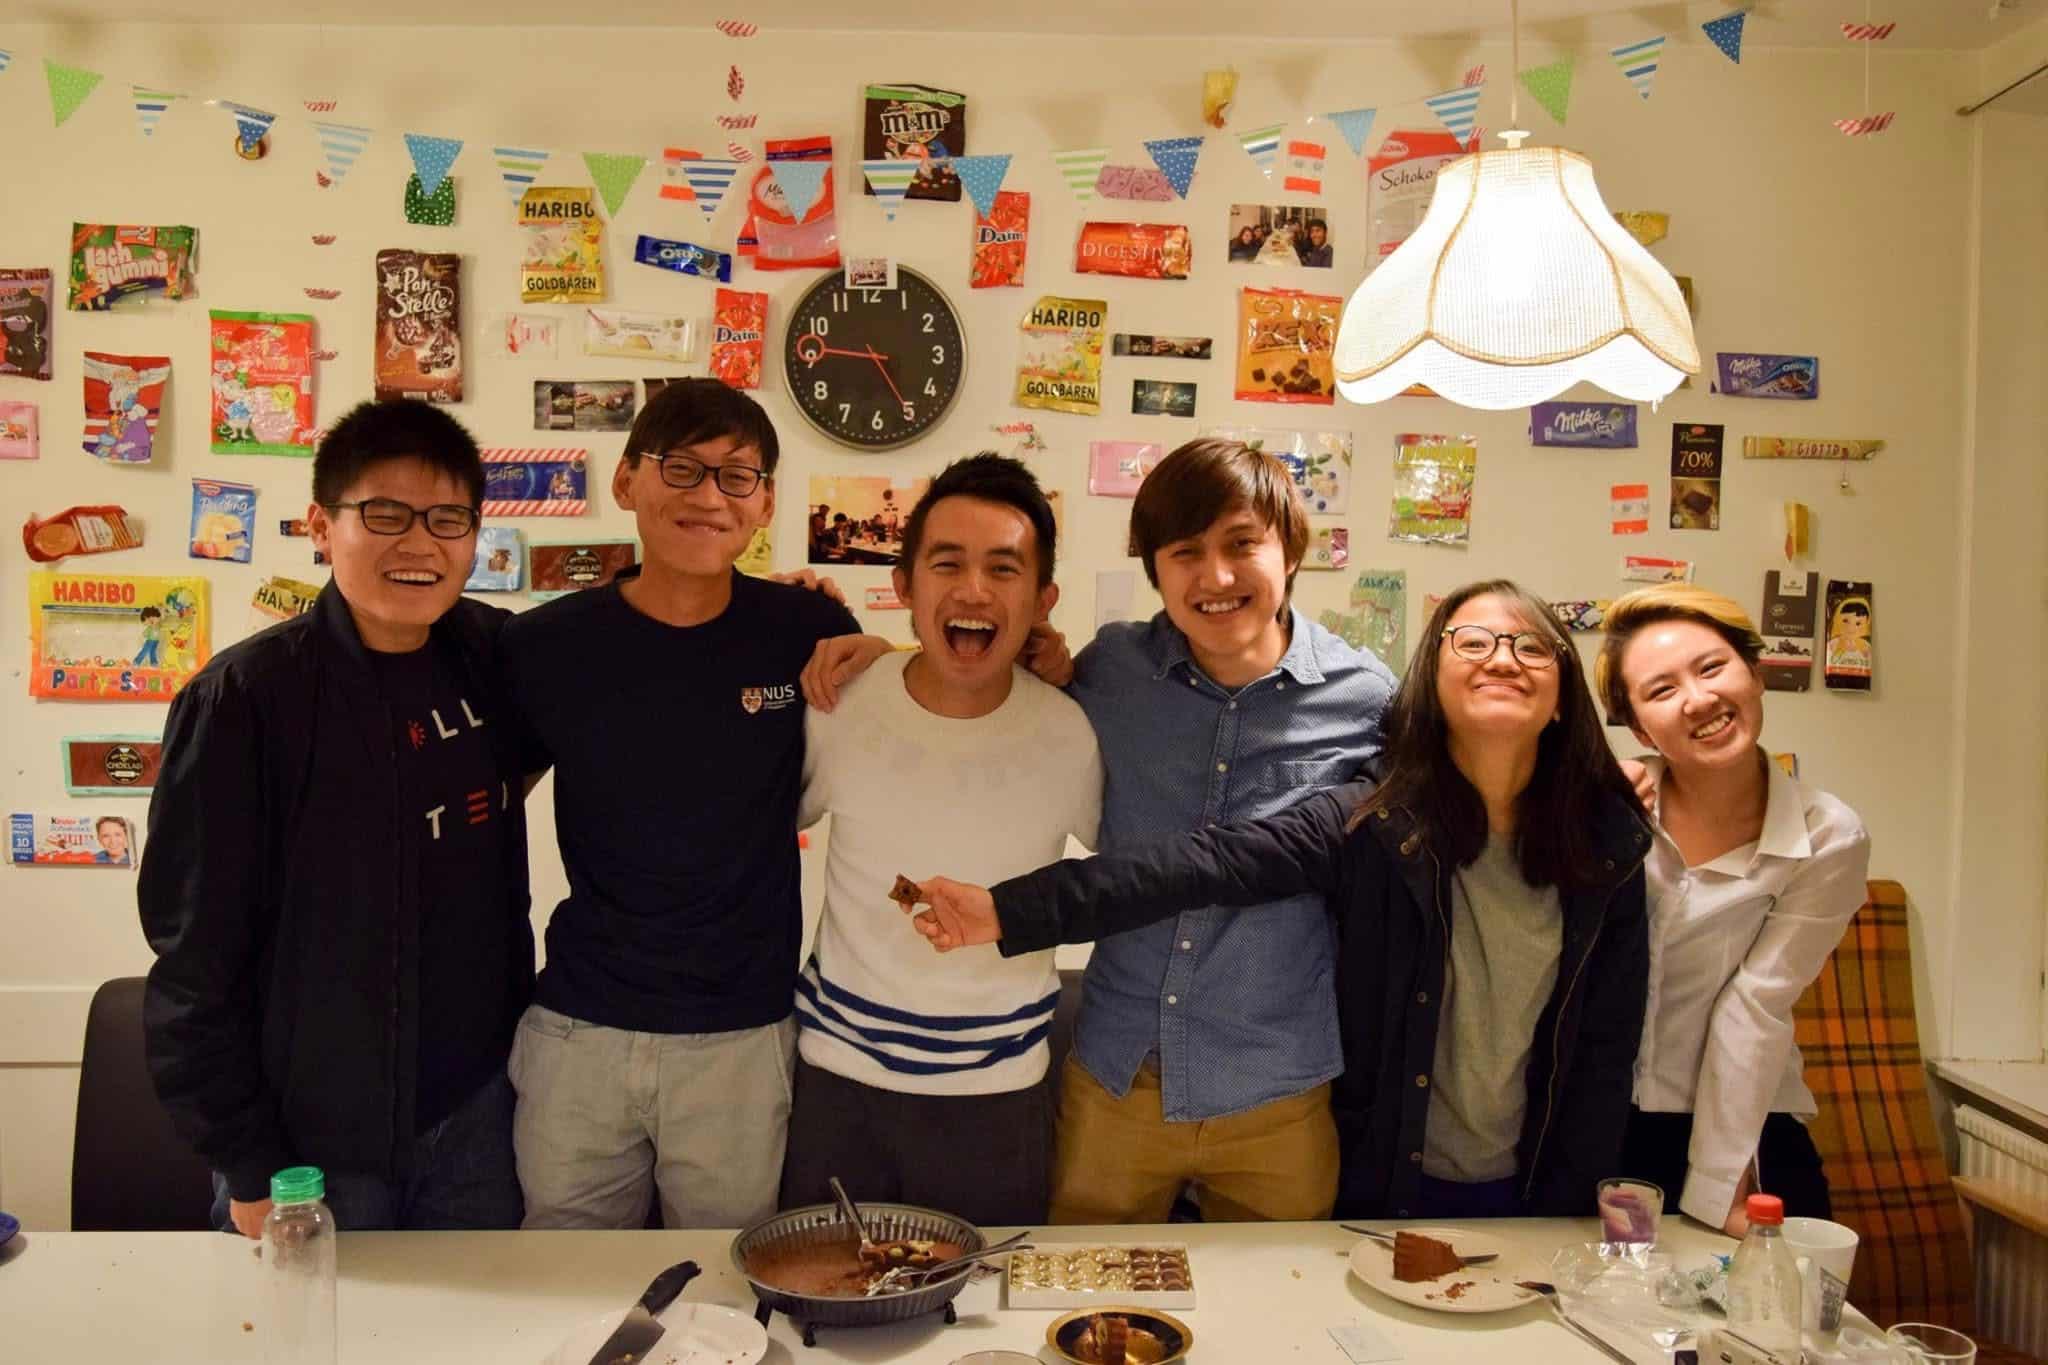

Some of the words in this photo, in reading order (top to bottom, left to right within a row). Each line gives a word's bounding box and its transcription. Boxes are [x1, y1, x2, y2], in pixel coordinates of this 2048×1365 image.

[979, 227, 1024, 243] Daim
[403, 266, 431, 294] Pan
[388, 290, 448, 318] Stelle
[833, 292, 848, 312] 11
[901, 290, 908, 311] 1
[809, 316, 828, 336] 10
[922, 313, 936, 333] 2
[1031, 307, 1101, 328] HARIBO
[717, 326, 760, 342] Daim
[932, 345, 944, 364] 3
[814, 380, 828, 400] 8
[923, 377, 937, 397] 4
[839, 403, 851, 423] 7
[871, 410, 884, 430] 6
[903, 401, 915, 421] 5
[1554, 408, 1601, 433] Milka
[1680, 451, 1714, 468] 70%
[53, 581, 135, 604] HARIBO
[763, 684, 795, 700] NUS
